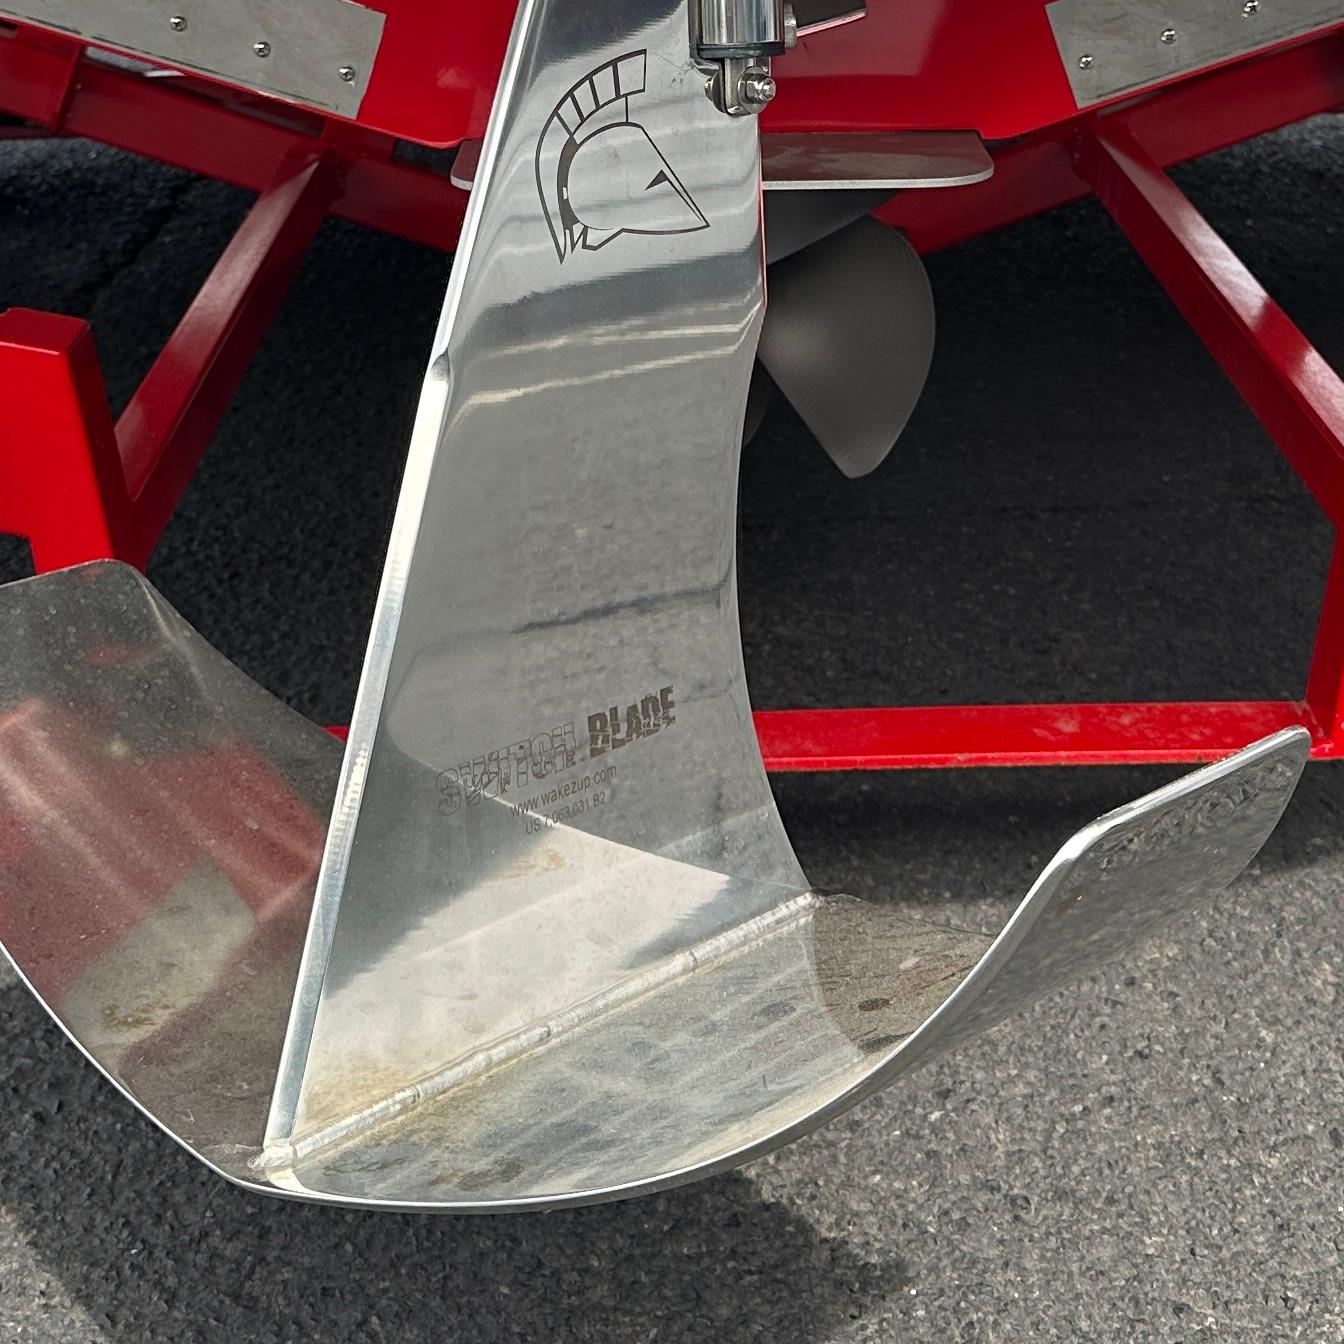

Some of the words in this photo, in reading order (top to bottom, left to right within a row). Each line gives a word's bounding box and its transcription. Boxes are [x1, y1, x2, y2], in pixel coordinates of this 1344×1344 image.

[587, 685, 676, 758] BLADE
[511, 765, 617, 816] www.wakezup.com
[525, 817, 541, 834] US
[593, 791, 606, 807] B2
